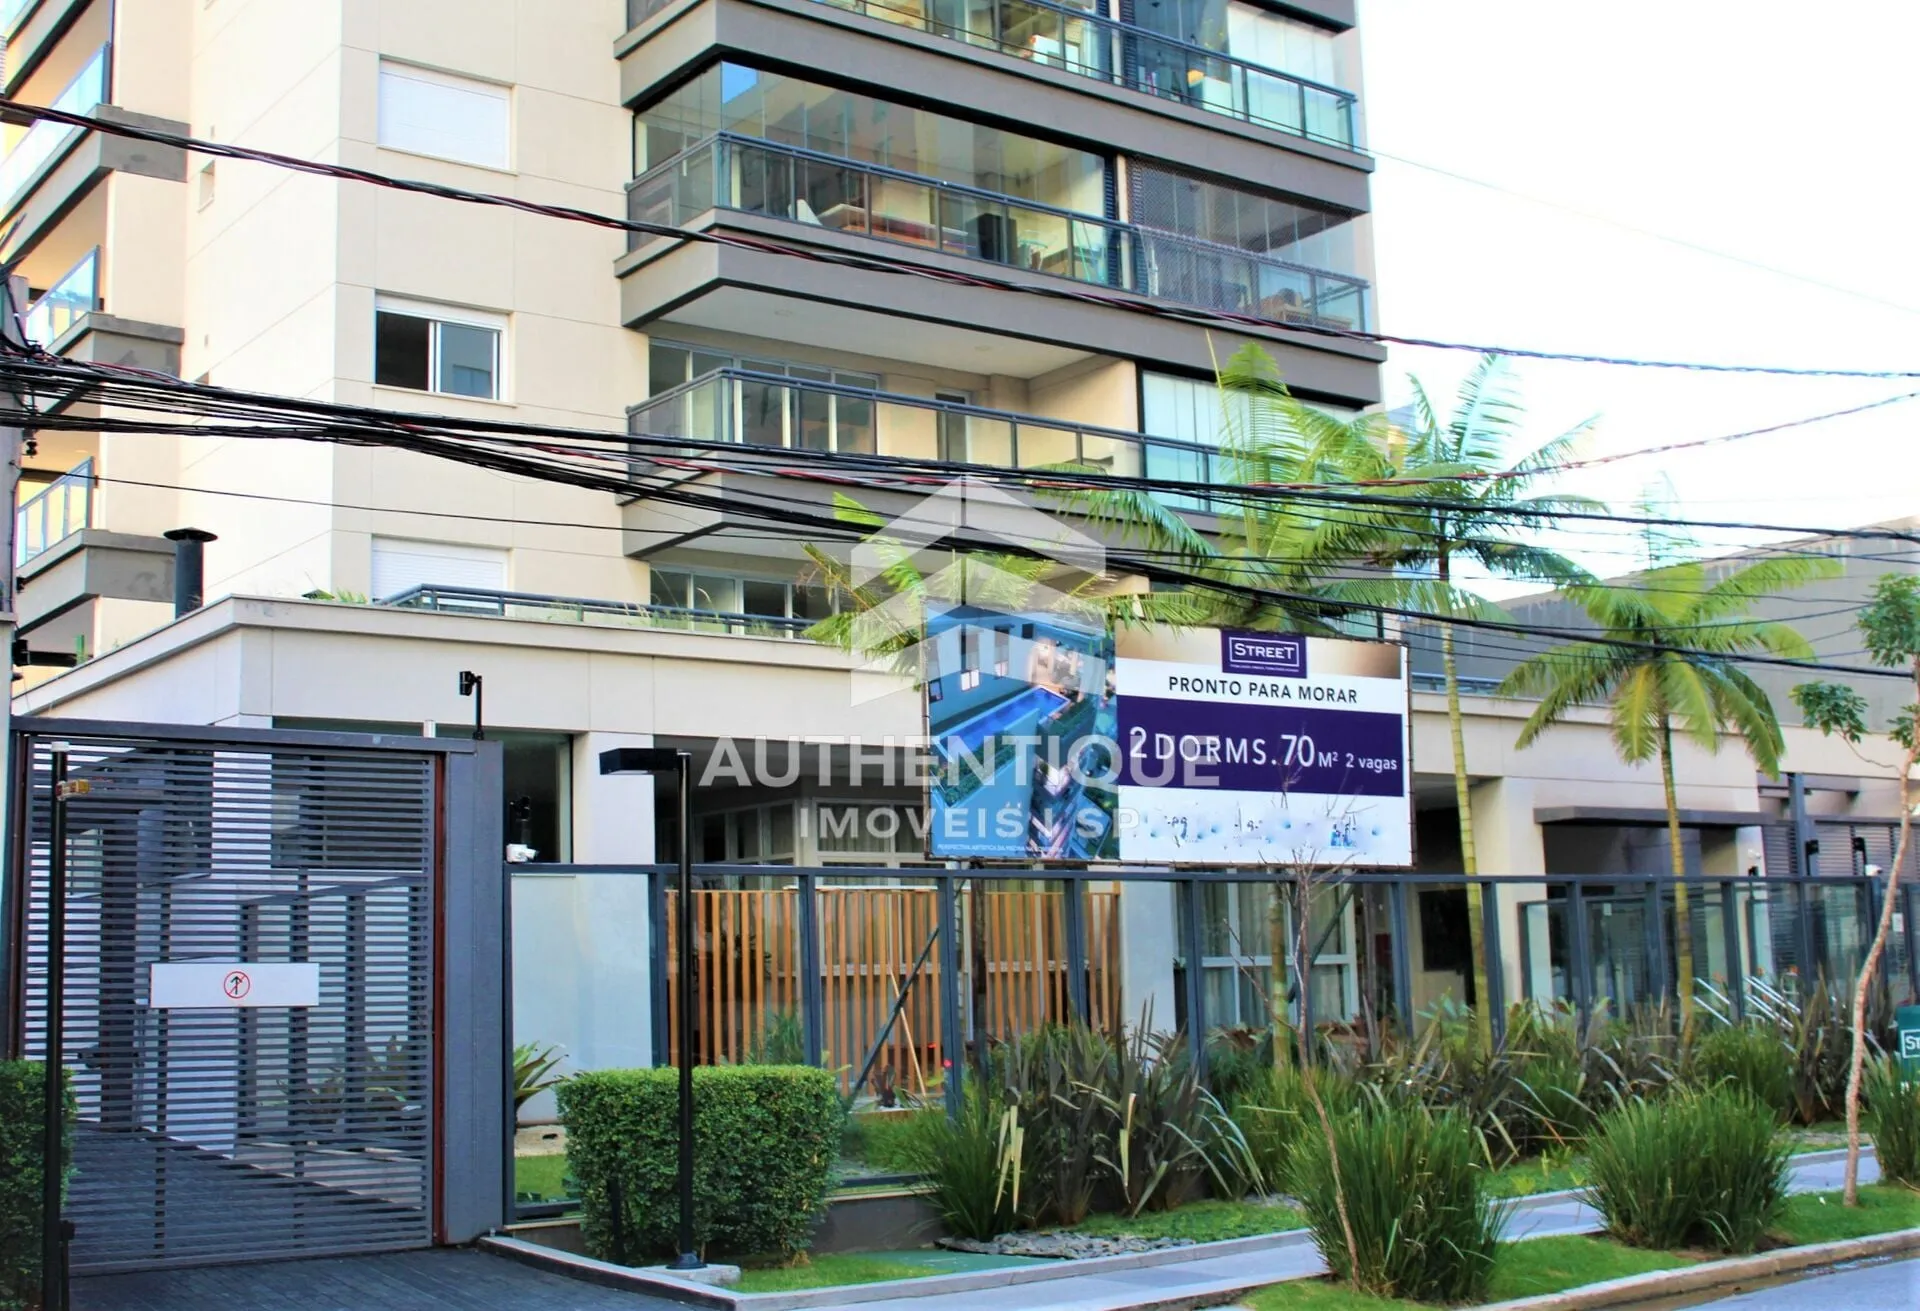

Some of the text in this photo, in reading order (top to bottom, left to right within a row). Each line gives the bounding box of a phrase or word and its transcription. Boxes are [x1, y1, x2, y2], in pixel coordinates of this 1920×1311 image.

[1234, 642, 1295, 660] STREET
[1168, 676, 1358, 704] PRONTO PARA MORAR
[1129, 726, 1148, 759] 2
[1345, 752, 1355, 769] 2
[1357, 757, 1398, 774] vagas
